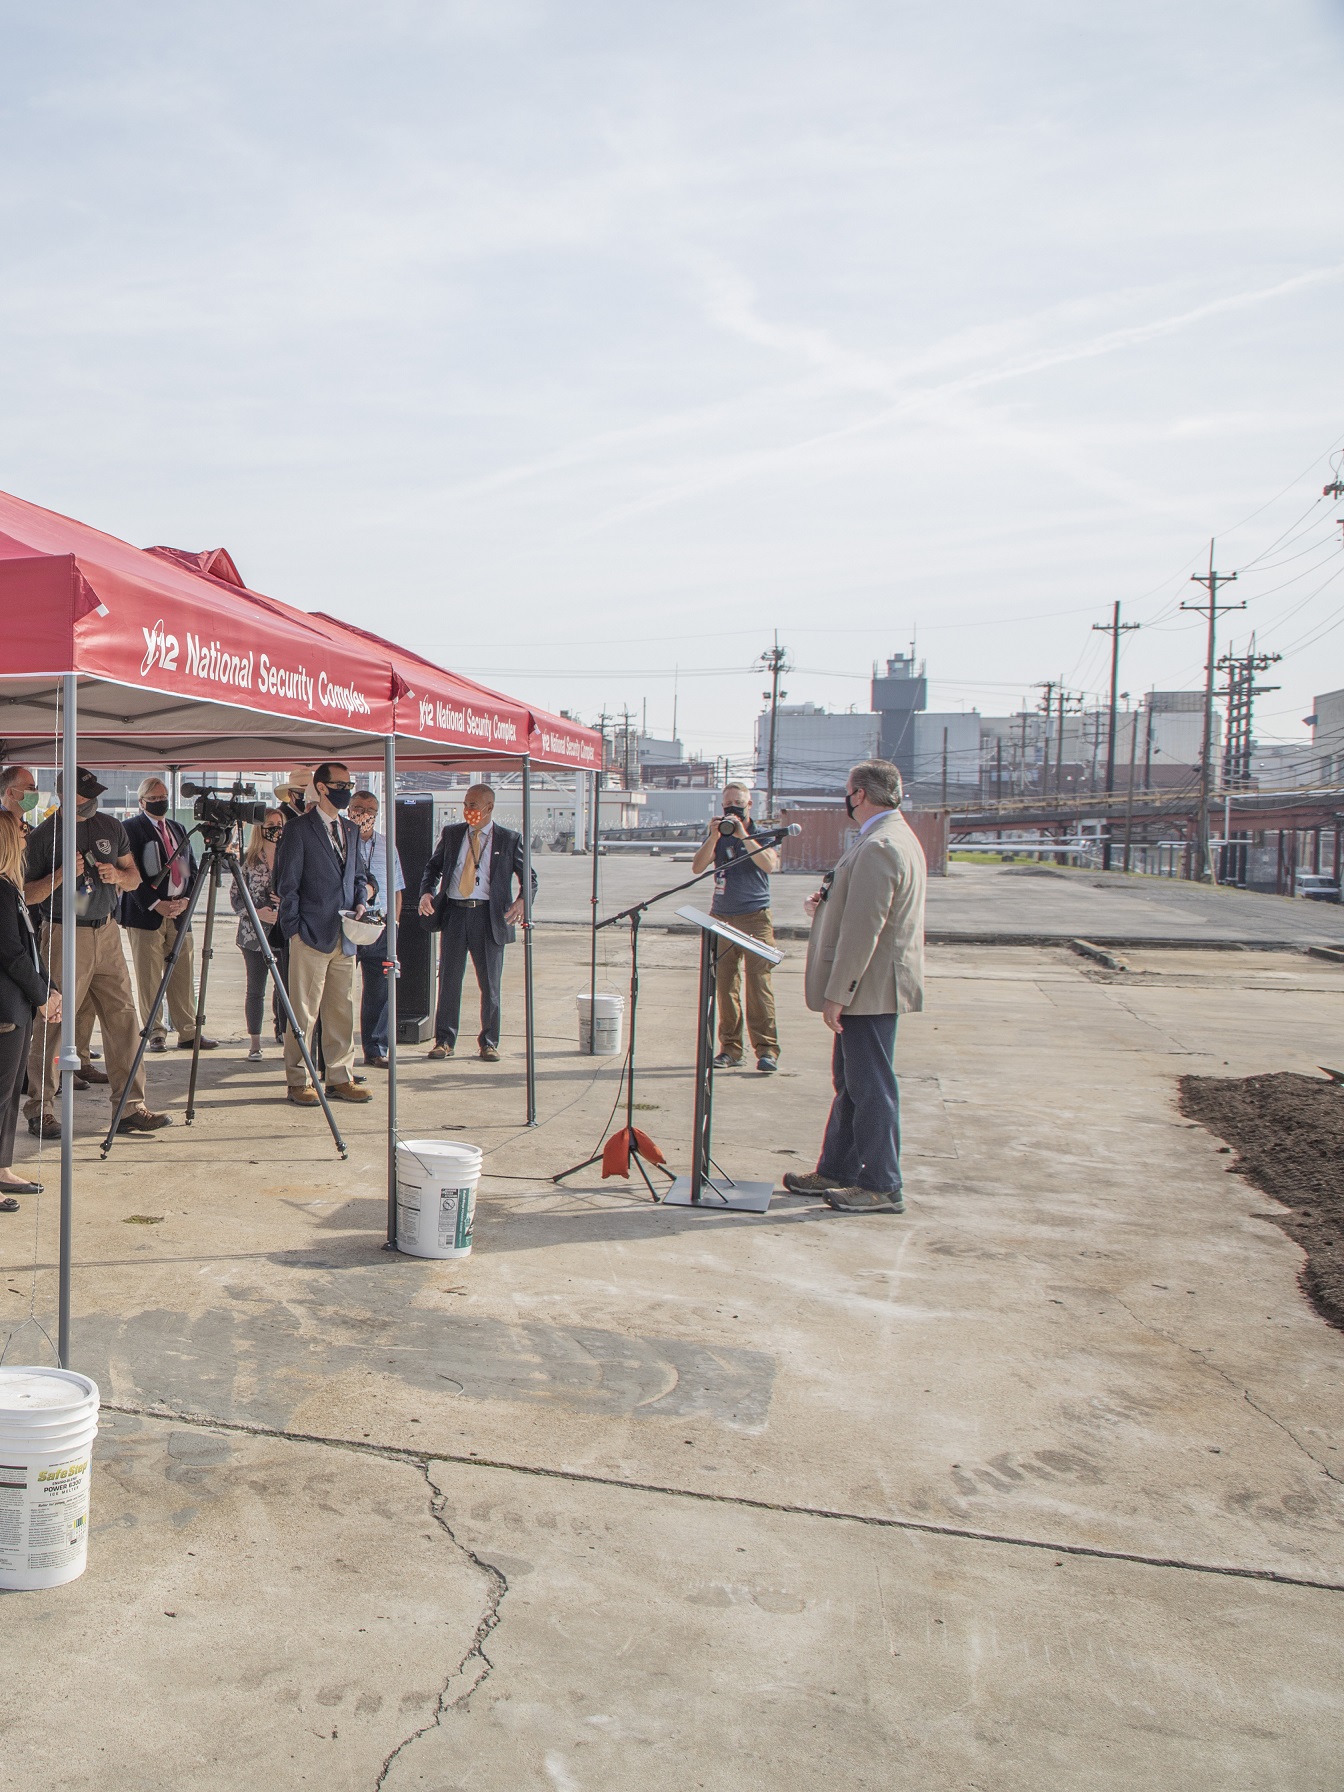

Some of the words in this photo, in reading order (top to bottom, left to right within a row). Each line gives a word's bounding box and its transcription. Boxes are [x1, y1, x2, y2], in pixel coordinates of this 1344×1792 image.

[184, 632, 255, 689] National
[257, 653, 316, 712] Security
[318, 671, 372, 718] Complex
[436, 700, 466, 733] National
[466, 707, 492, 743] Security
[492, 714, 518, 746] Complex
[550, 732, 567, 755] National
[565, 735, 581, 762] Security
[580, 739, 596, 764] Complex
[43, 1483, 68, 1493] POWER
